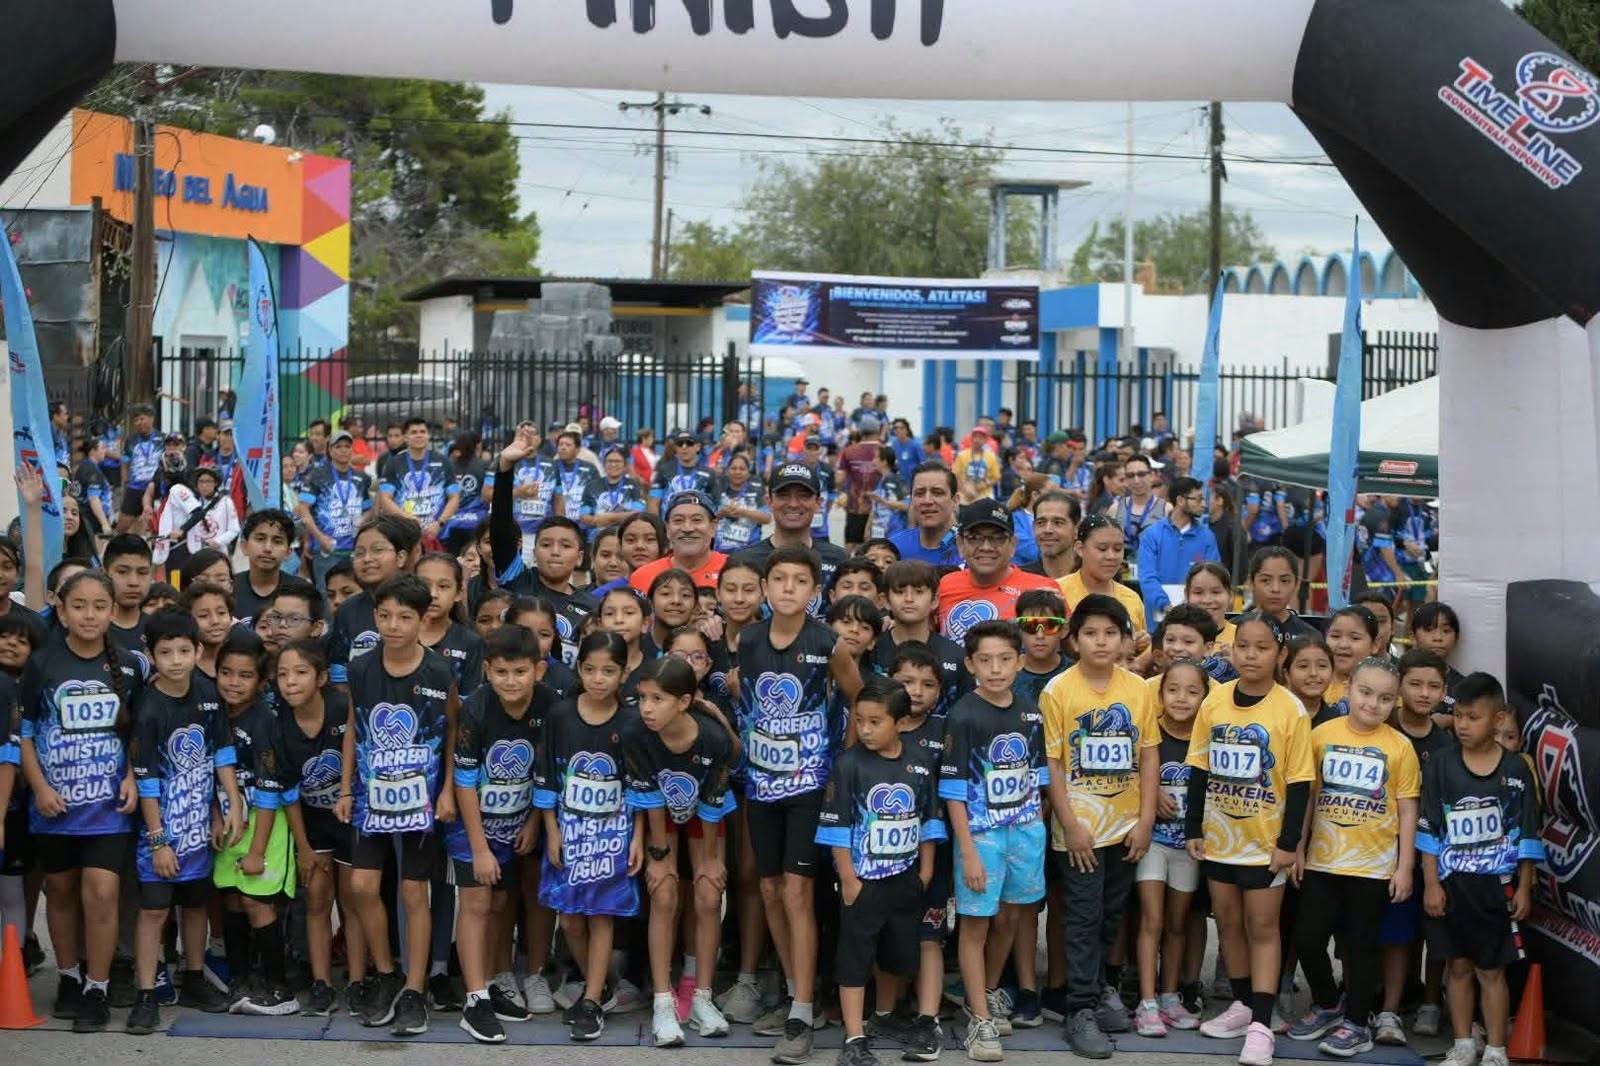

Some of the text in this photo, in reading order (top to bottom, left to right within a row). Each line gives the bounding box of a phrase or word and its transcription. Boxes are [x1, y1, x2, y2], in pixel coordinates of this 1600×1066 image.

[1439, 86, 1561, 188] CRONOMETRAJE DEPORTIVO
[183, 175, 213, 204] DEL
[67, 701, 115, 721] 1037
[48, 739, 120, 766] AMISTAD
[752, 739, 794, 764] 1002
[1086, 743, 1130, 762] 1031
[1212, 750, 1256, 770] 1017
[53, 760, 115, 782] CUIDADO
[1328, 758, 1378, 783] 1014
[62, 779, 112, 802] AGUA
[374, 784, 420, 805] 1001
[571, 783, 618, 806] 1004
[760, 773, 815, 796] AGUA
[877, 824, 917, 847] 1078
[1451, 814, 1498, 836] 1010
[573, 857, 611, 881] AGUA
